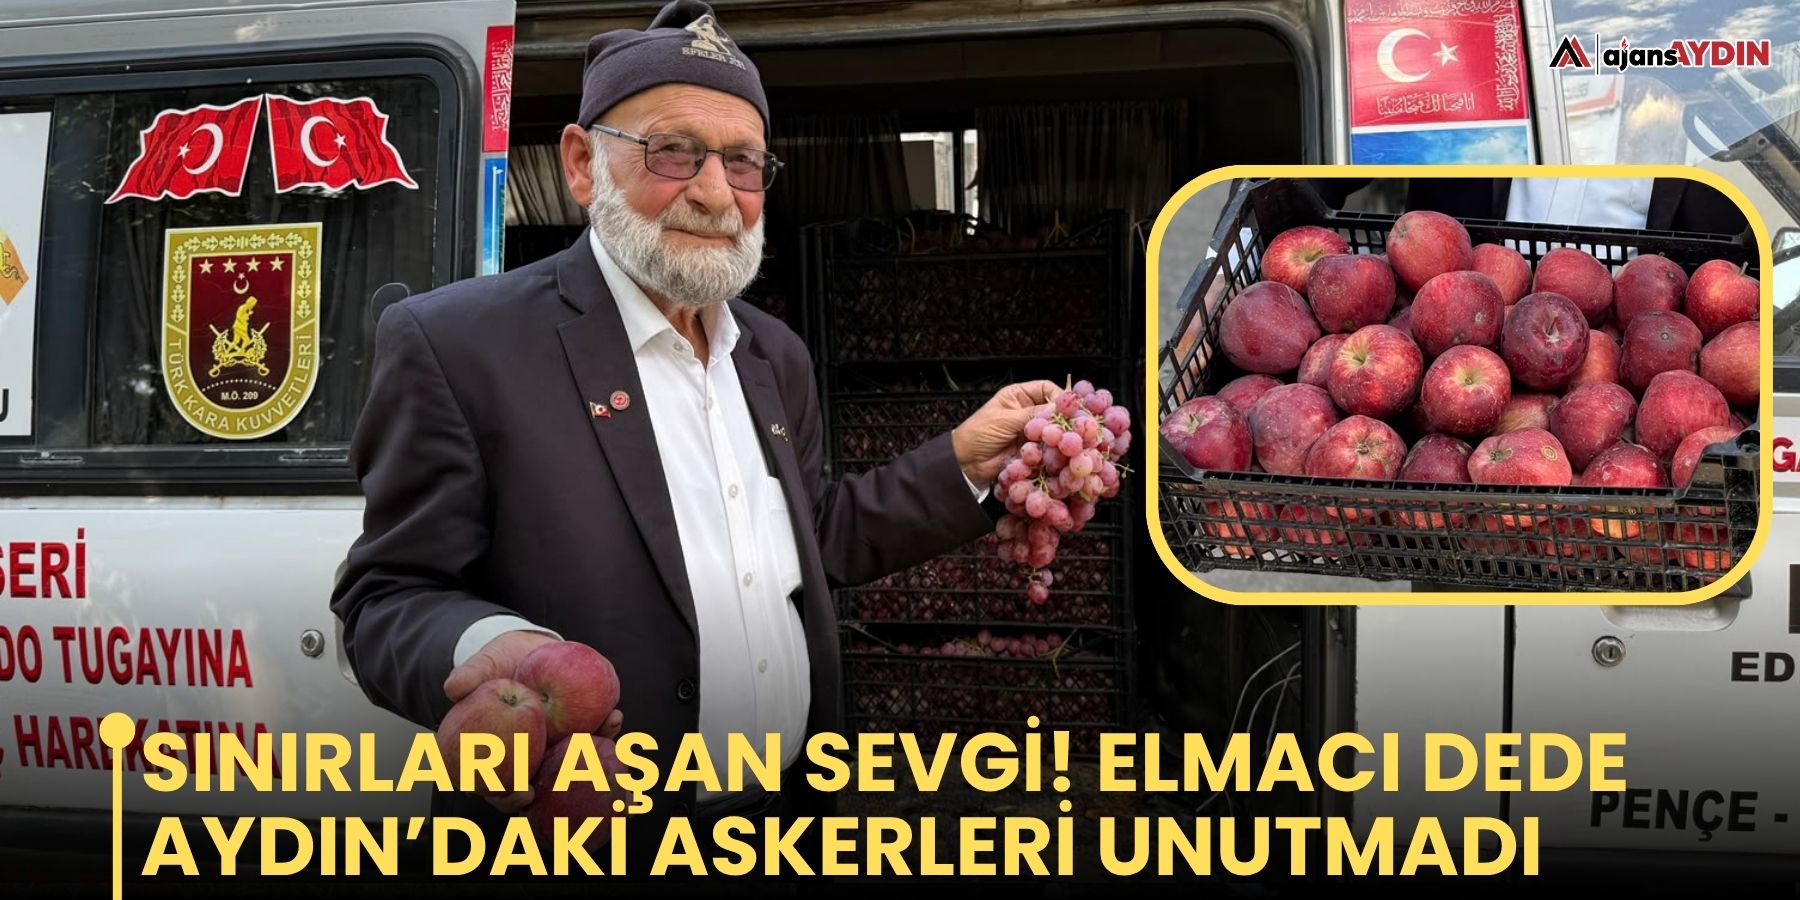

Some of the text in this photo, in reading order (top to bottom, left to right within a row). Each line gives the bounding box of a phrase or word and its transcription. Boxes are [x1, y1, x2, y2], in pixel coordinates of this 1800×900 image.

[169, 334, 312, 431] TÜRK KARA KUVVETLERİ
[243, 391, 259, 400] 209
[0, 528, 86, 599] ERİ
[53, 625, 254, 688] TUGAYINA
[1731, 651, 1796, 683] ED
[1590, 788, 1758, 842] PENÇE
